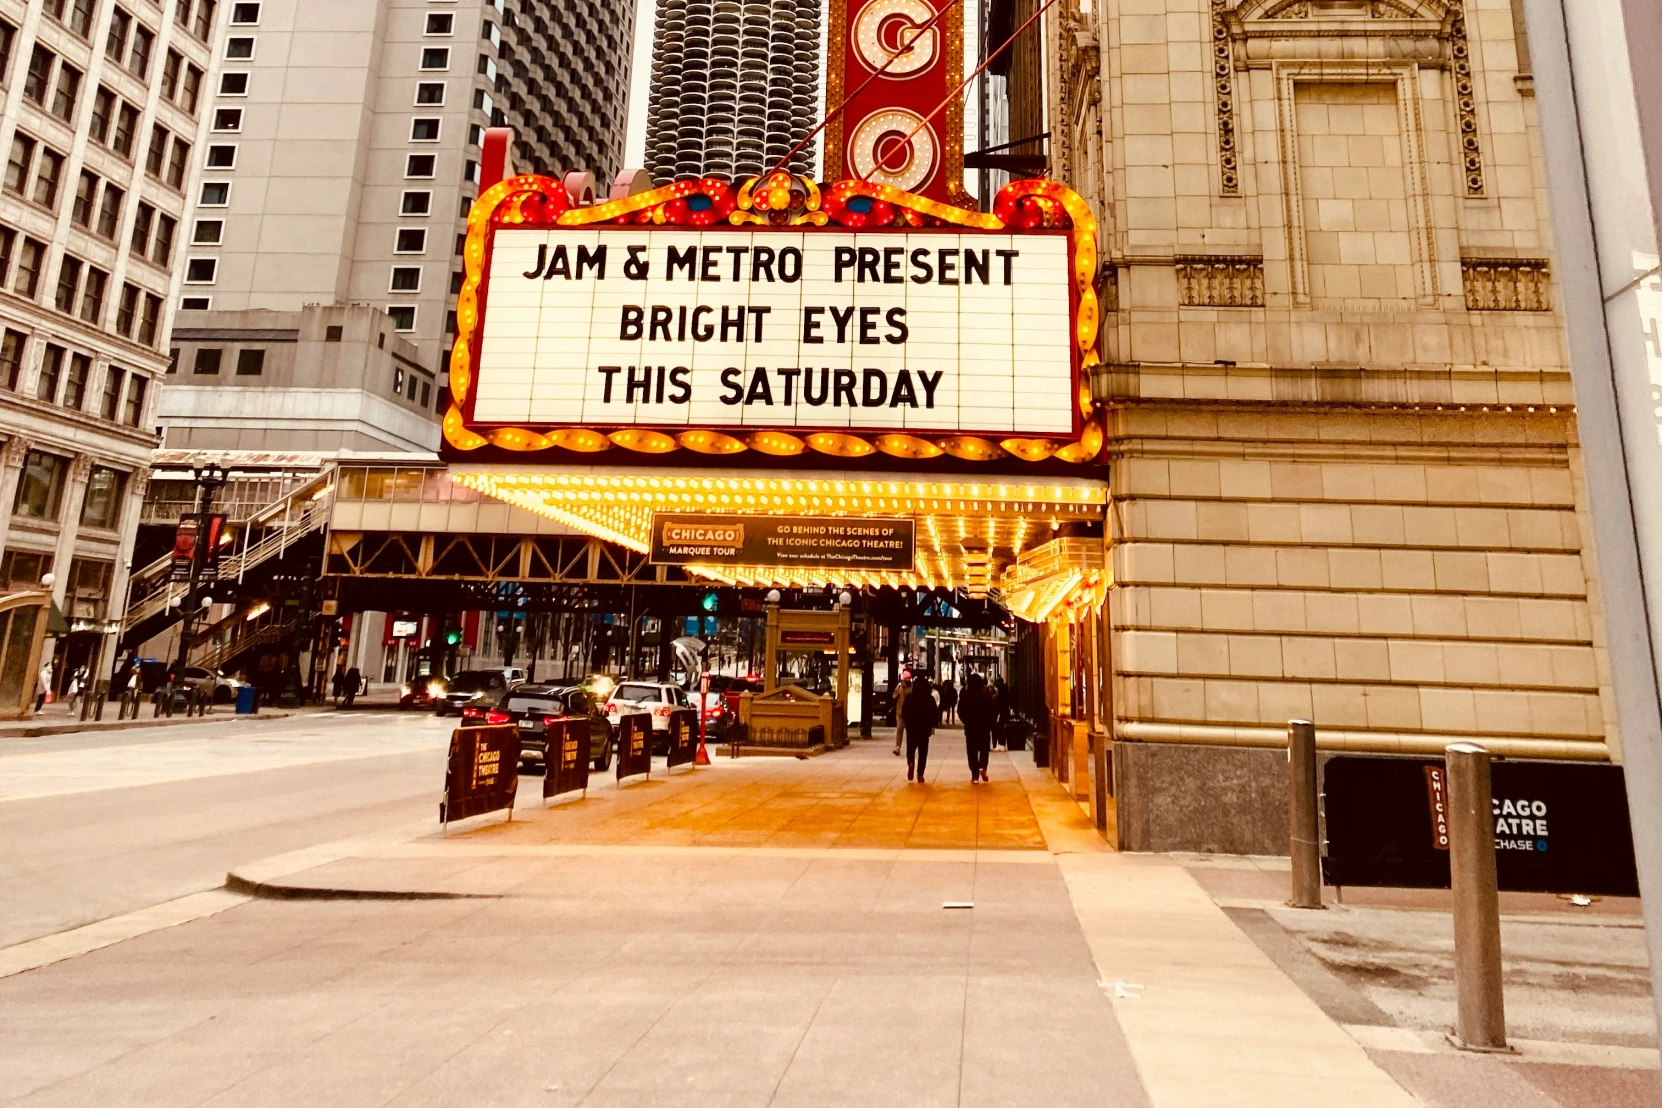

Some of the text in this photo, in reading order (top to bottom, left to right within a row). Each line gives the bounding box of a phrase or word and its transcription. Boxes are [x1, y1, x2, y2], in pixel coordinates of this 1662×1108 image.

[522, 244, 1020, 286] JAM & METRO PRESENT
[619, 304, 909, 345] BRIGHT EYES
[598, 366, 943, 409] THIS SATURDAY
[671, 529, 735, 541] CHICAGO
[777, 525, 894, 537] GO BEHIND THE SCENES OF
[767, 537, 903, 549] THE ICONIC CHICAGO THEATRE!
[669, 546, 736, 556] MARQUEE TOUR
[478, 750, 501, 764] CHICAGO
[478, 762, 500, 777] THEATRE
[1431, 770, 1448, 845] CHICAGO
[1494, 839, 1534, 851] CHASE
